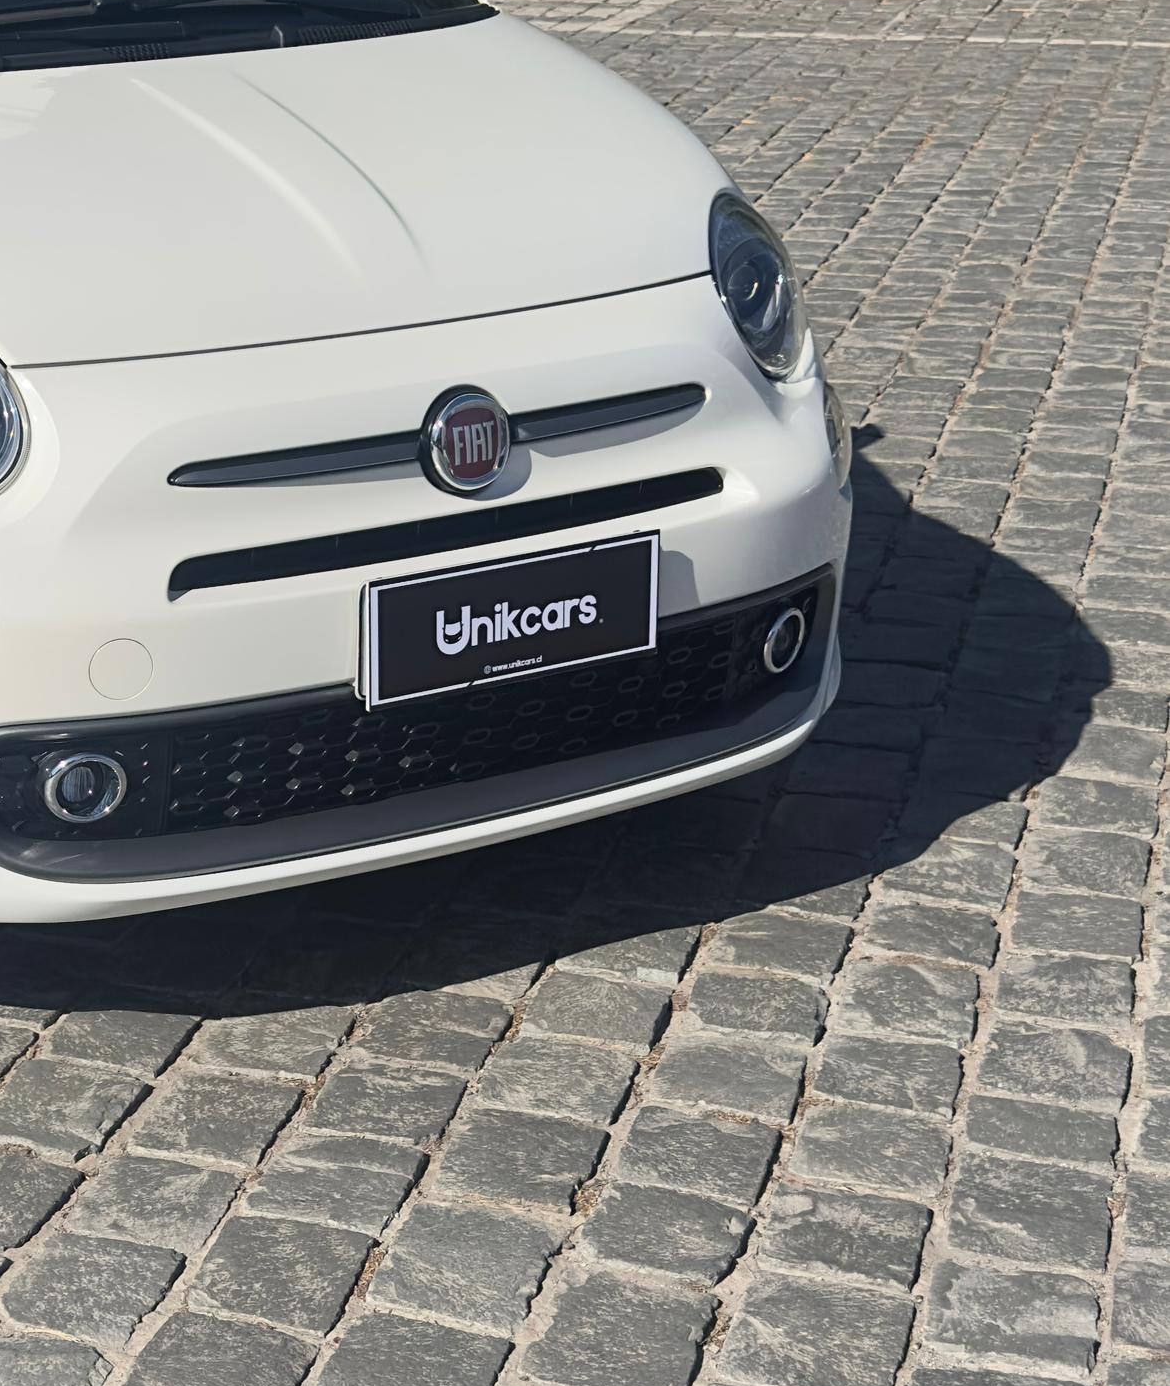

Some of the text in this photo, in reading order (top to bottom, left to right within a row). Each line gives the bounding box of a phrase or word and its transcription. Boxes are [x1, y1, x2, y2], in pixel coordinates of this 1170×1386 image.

[452, 420, 494, 466] FIAT
[436, 594, 598, 656] Unikcars
[492, 654, 543, 672] www.unikcars.cl
